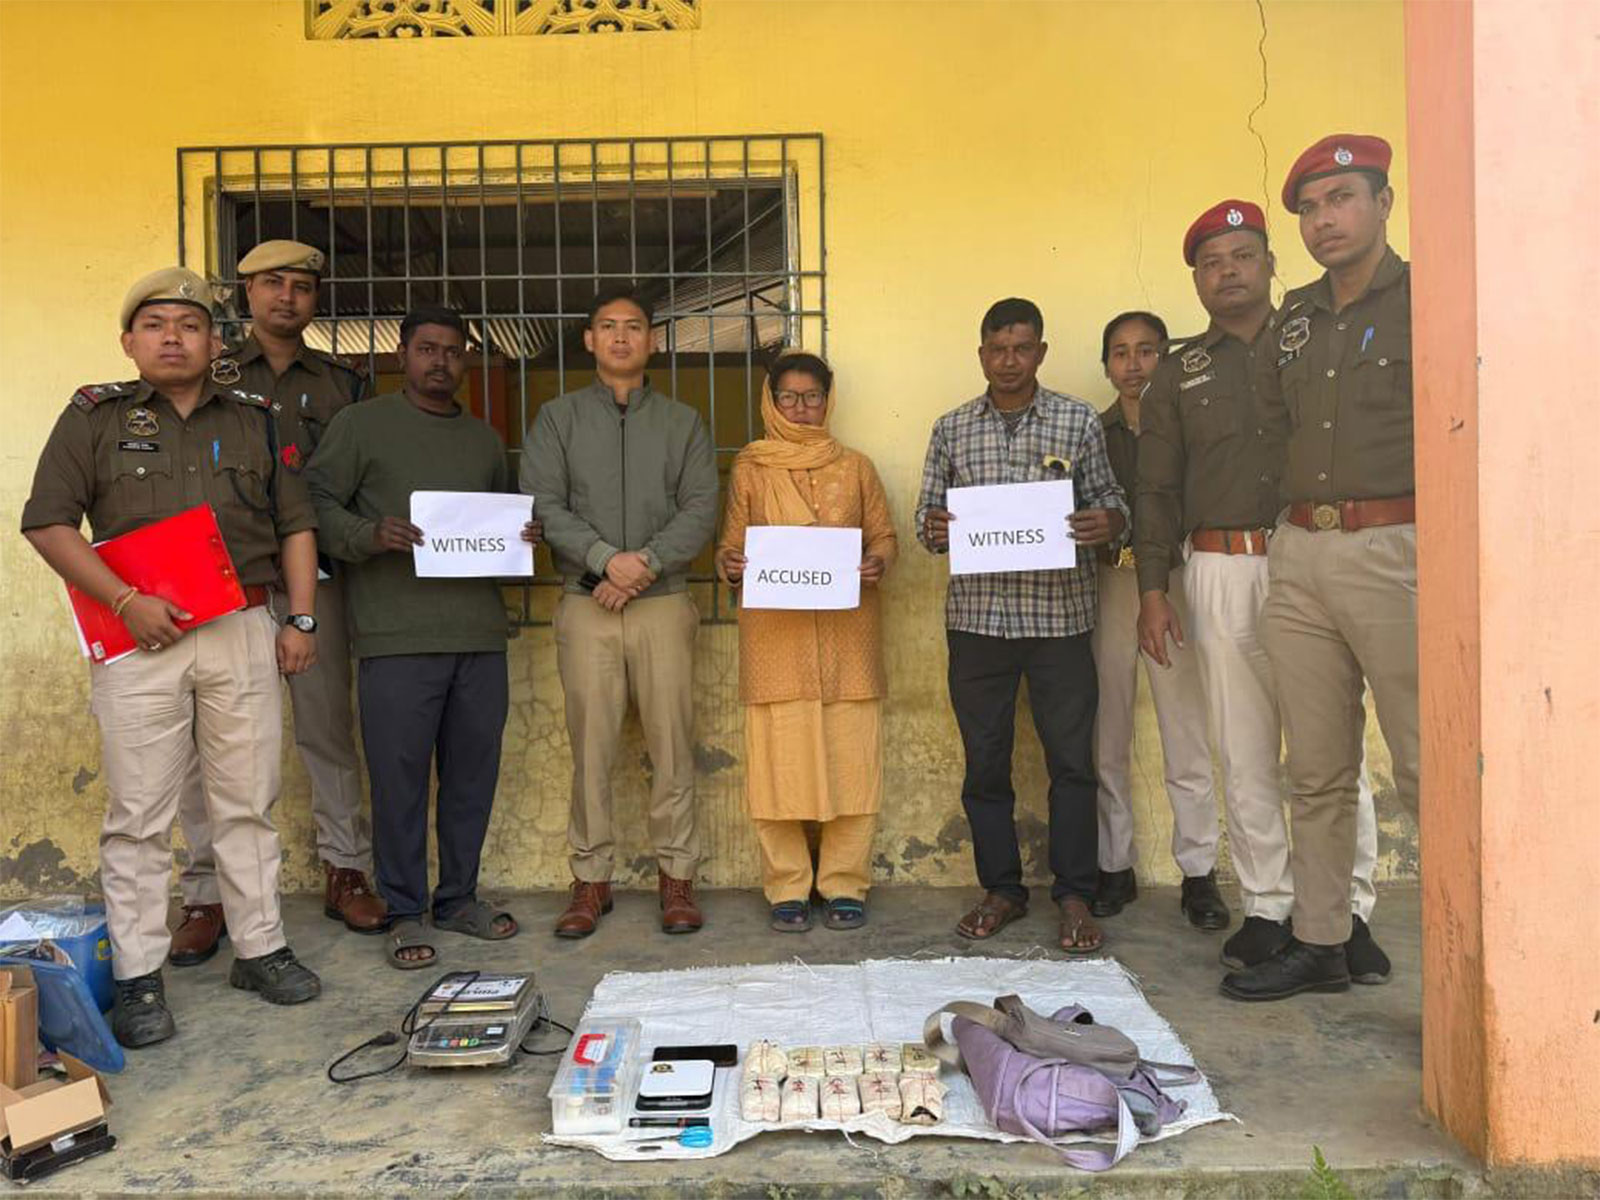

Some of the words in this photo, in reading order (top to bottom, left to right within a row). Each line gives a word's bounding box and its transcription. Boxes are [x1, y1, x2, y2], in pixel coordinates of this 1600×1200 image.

[431, 537, 506, 553] WITNESS
[968, 528, 1045, 547] WITNESS
[757, 569, 832, 586] ACCUSED
